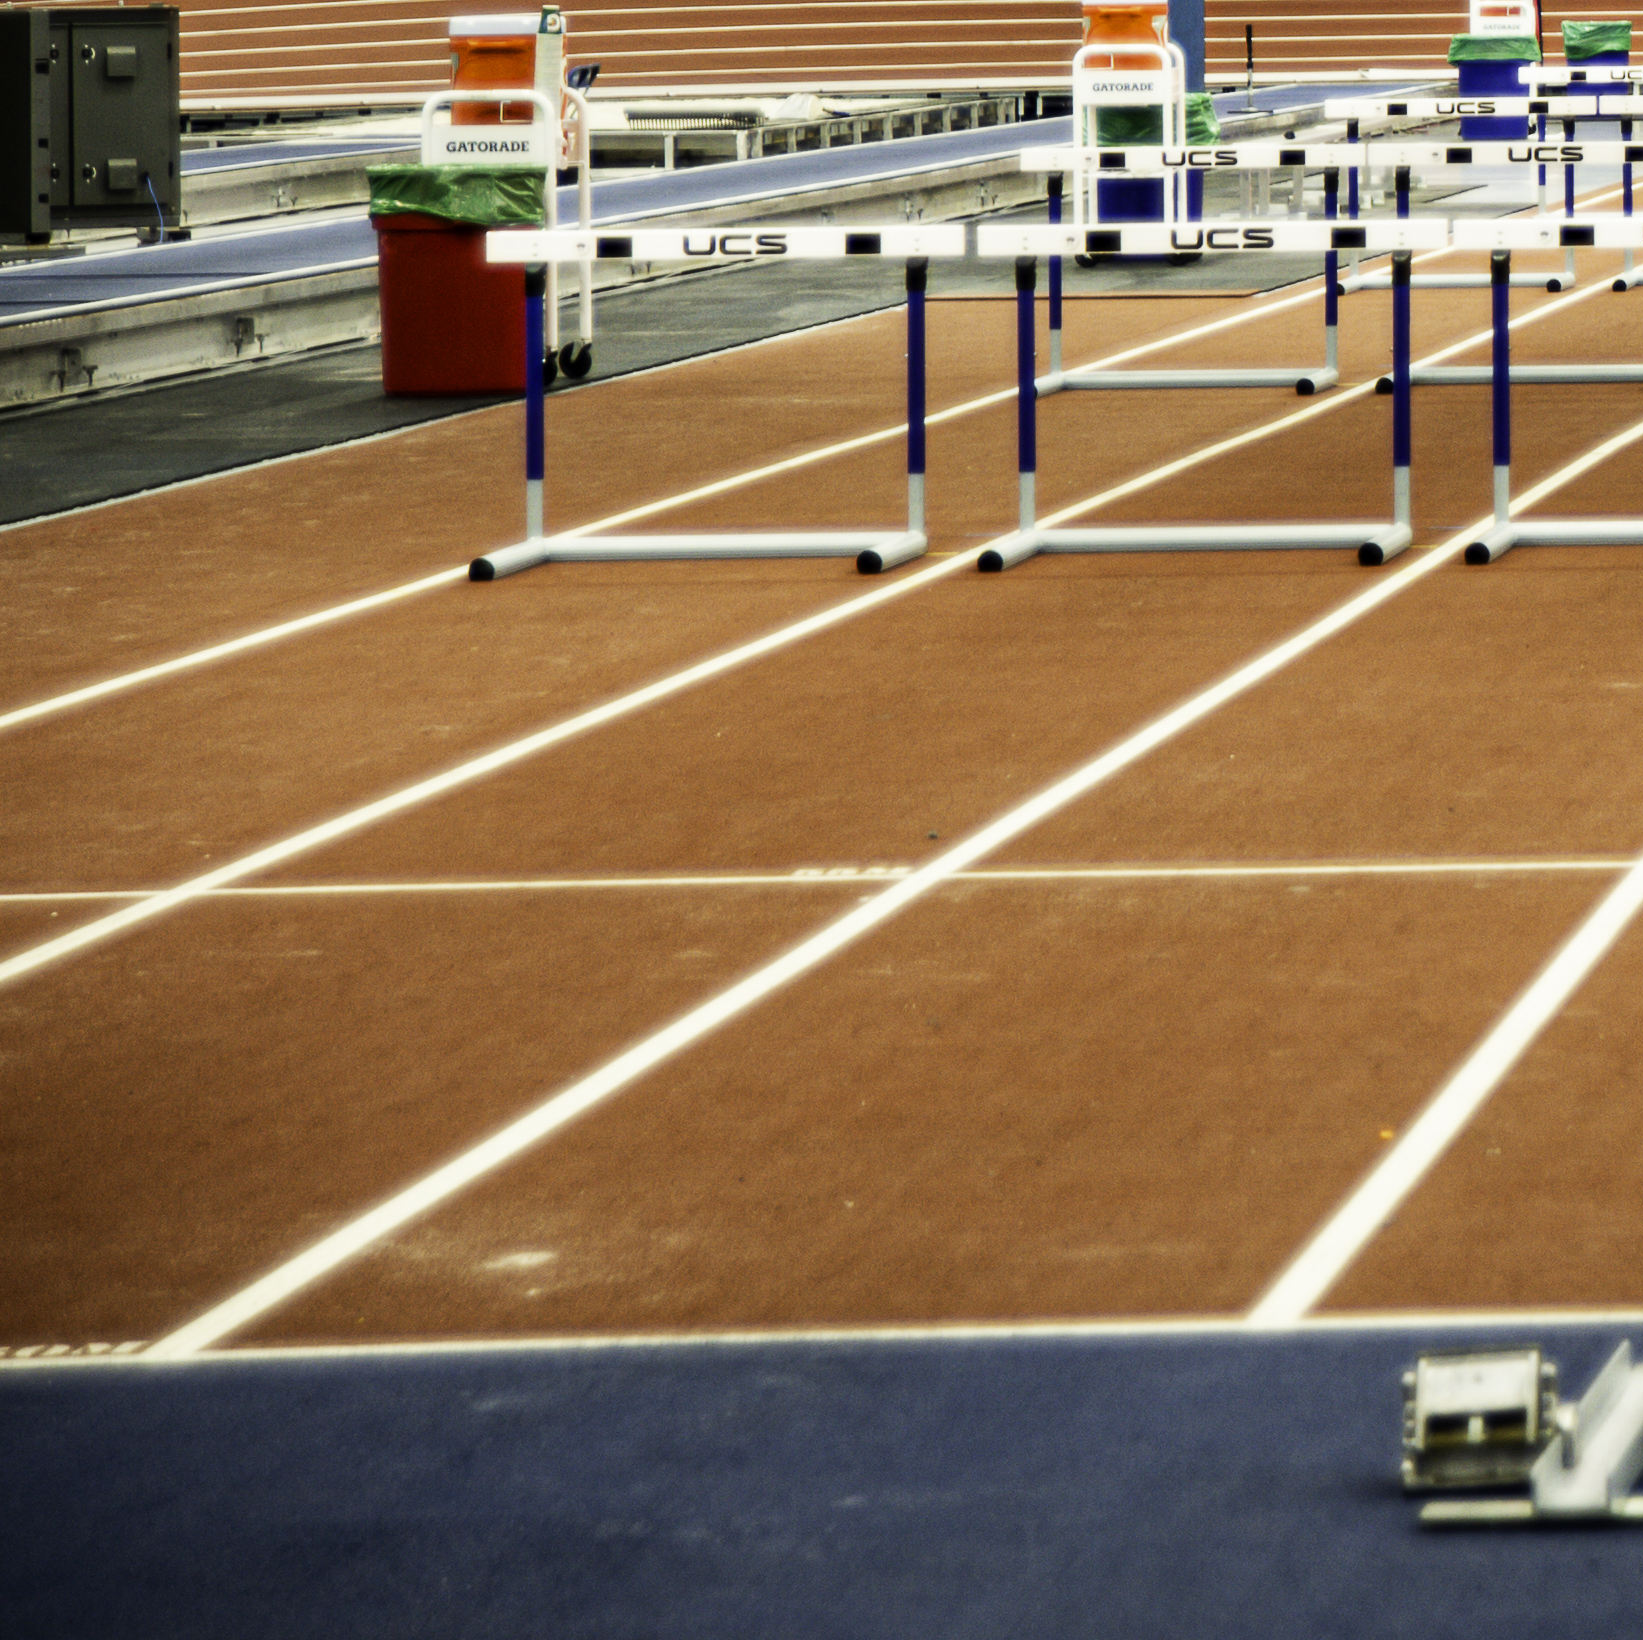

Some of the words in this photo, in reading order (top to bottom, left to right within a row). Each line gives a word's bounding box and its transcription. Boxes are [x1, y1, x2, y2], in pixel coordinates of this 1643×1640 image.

[1092, 82, 1154, 92] GATORADE
[1435, 101, 1495, 115] UCS
[445, 140, 531, 154] GATORADE
[1508, 146, 1583, 163] UCS
[1161, 150, 1237, 167] UCS
[683, 234, 787, 255] UCS
[1171, 228, 1274, 250] UCS
